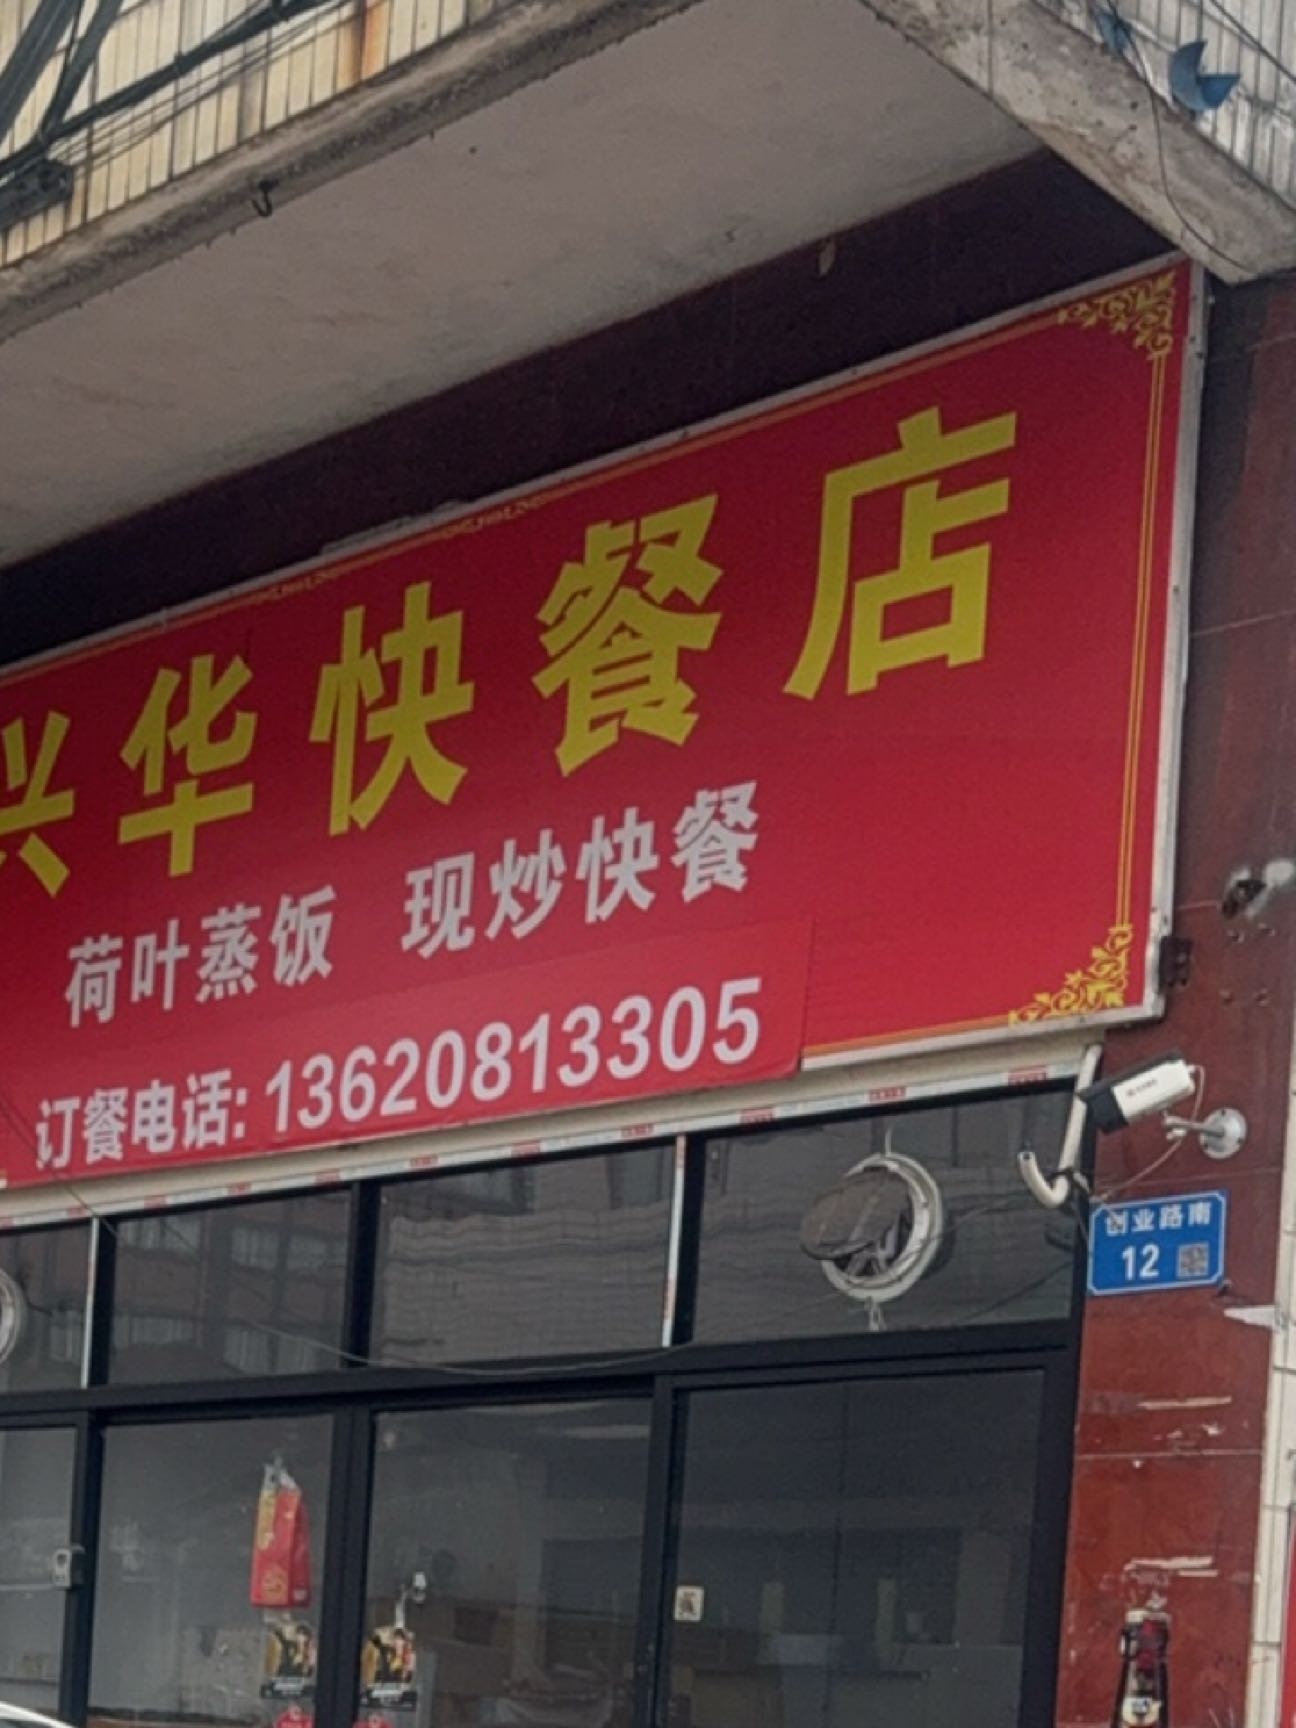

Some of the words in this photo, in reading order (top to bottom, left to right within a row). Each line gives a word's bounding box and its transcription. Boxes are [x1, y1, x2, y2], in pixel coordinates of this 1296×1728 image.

[66, 885, 336, 1027] 荷叶蒸饭
[402, 781, 757, 959] 现炒快餐
[264, 977, 762, 1133] 13620813305
[1106, 1201, 1211, 1236] 创业路南
[1122, 1244, 1160, 1280] 12
